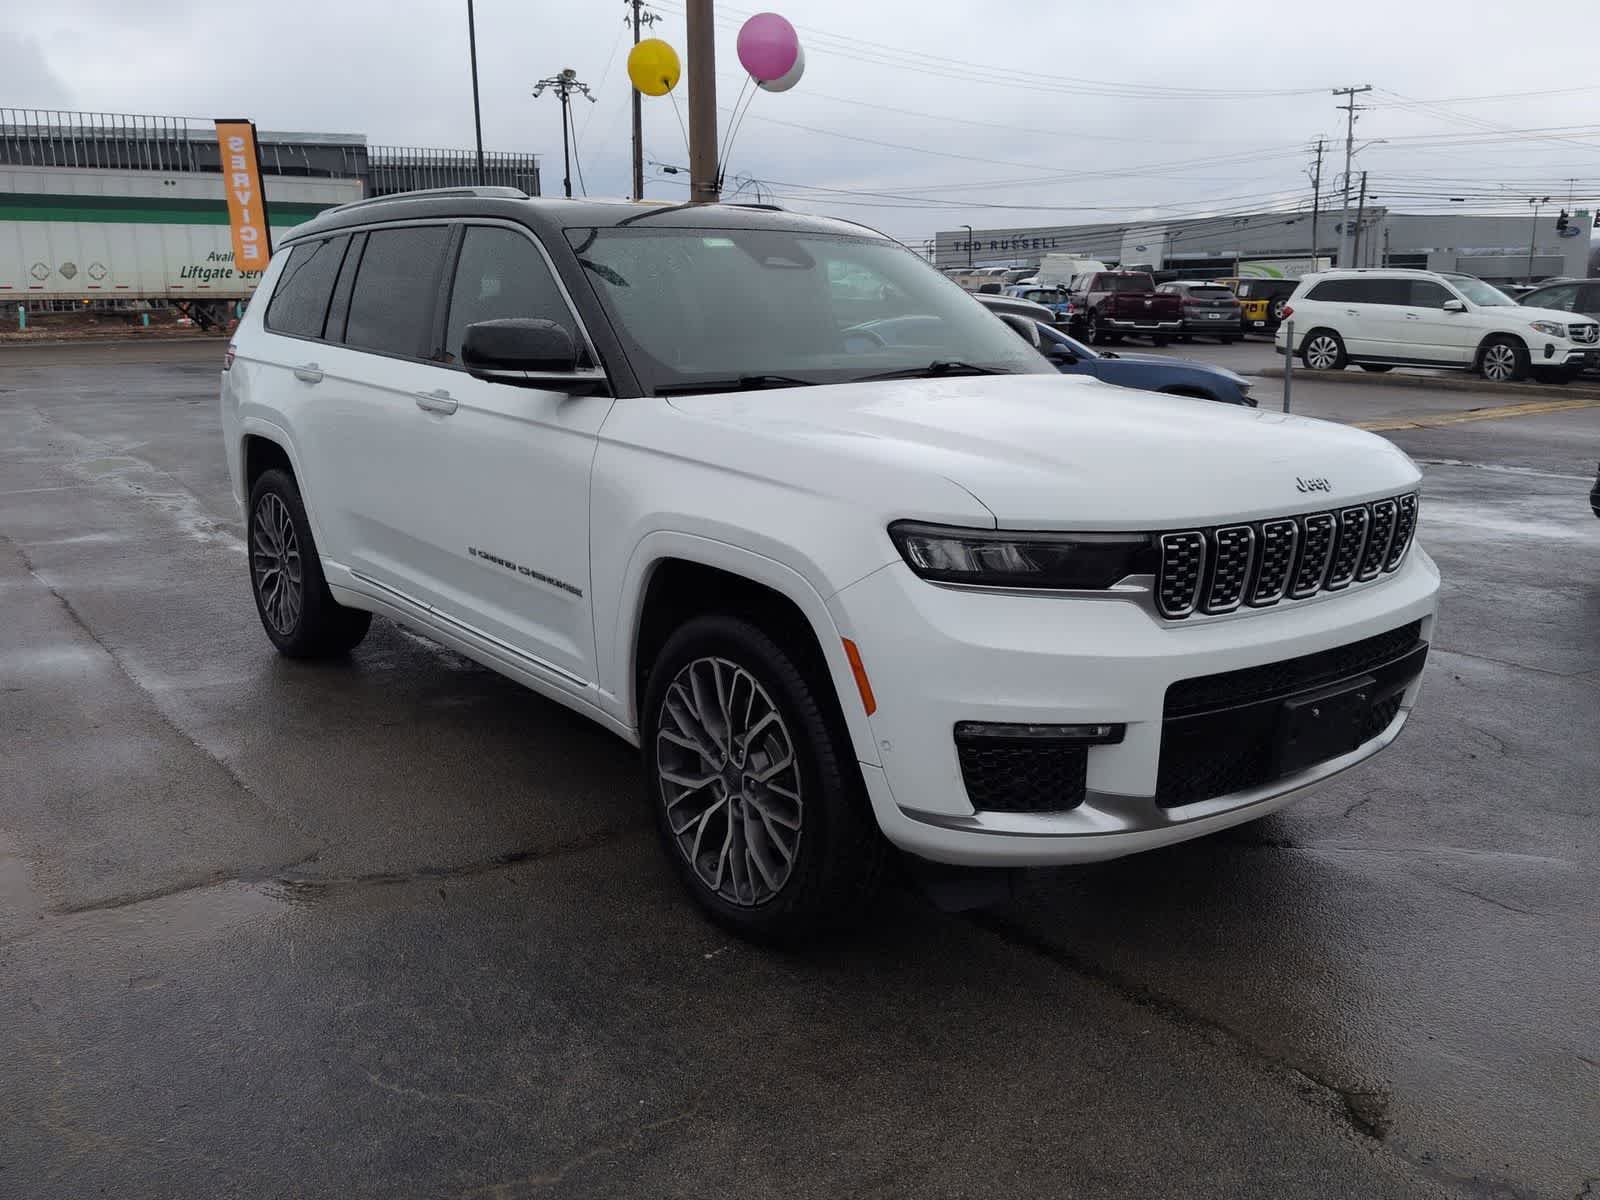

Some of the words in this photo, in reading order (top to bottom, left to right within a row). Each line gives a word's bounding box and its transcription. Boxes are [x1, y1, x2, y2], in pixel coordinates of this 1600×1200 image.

[954, 240, 981, 251] TED
[990, 238, 1059, 250] RUSSELL
[180, 266, 233, 282] Liftgate
[1296, 477, 1331, 493] Jeep
